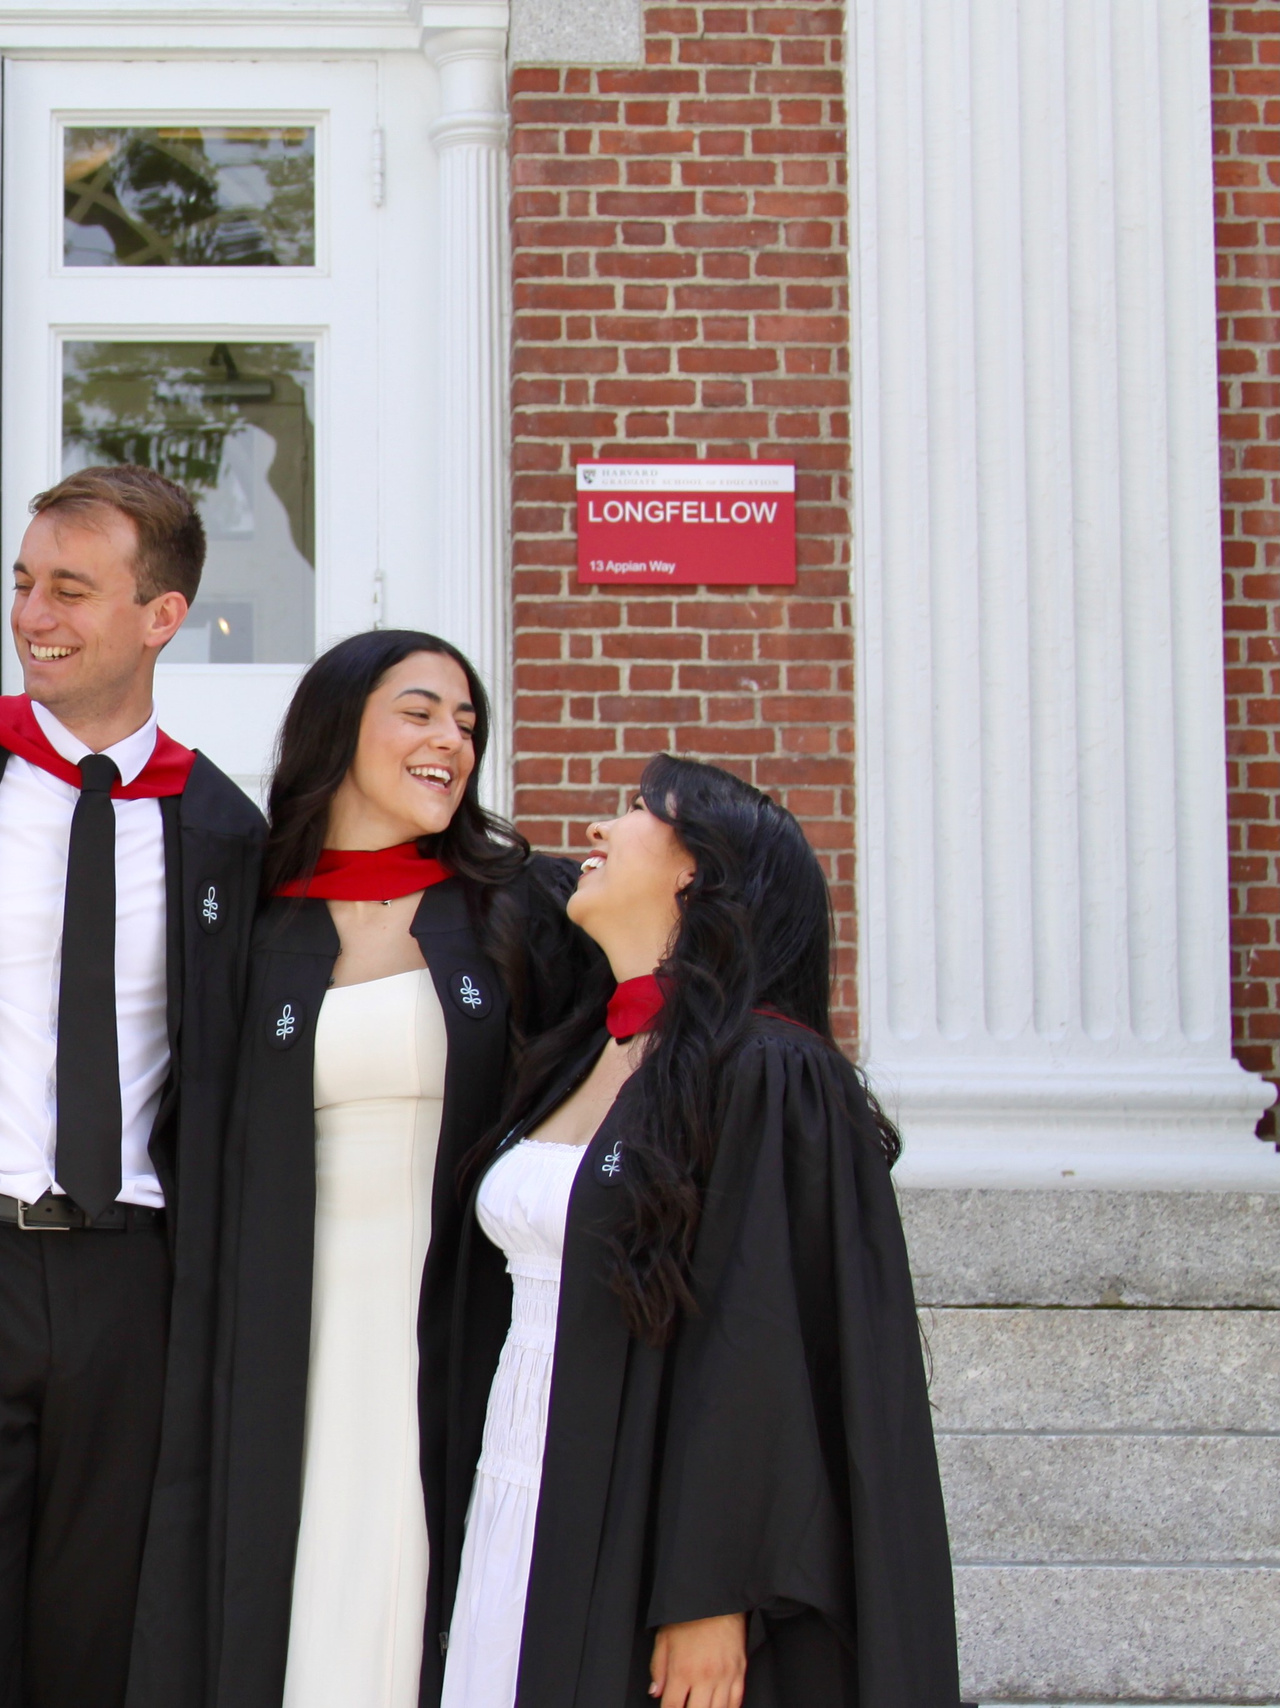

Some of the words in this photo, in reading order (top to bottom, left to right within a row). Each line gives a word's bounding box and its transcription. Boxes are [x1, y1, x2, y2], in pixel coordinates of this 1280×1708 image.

[601, 469, 659, 477] HARVARD
[601, 478, 657, 486] GRADUATE
[662, 478, 703, 486] SCHOOL
[587, 500, 778, 524] LONGFELLOW
[589, 560, 604, 572] 13
[606, 560, 647, 574] Appian
[649, 561, 676, 575] Way
